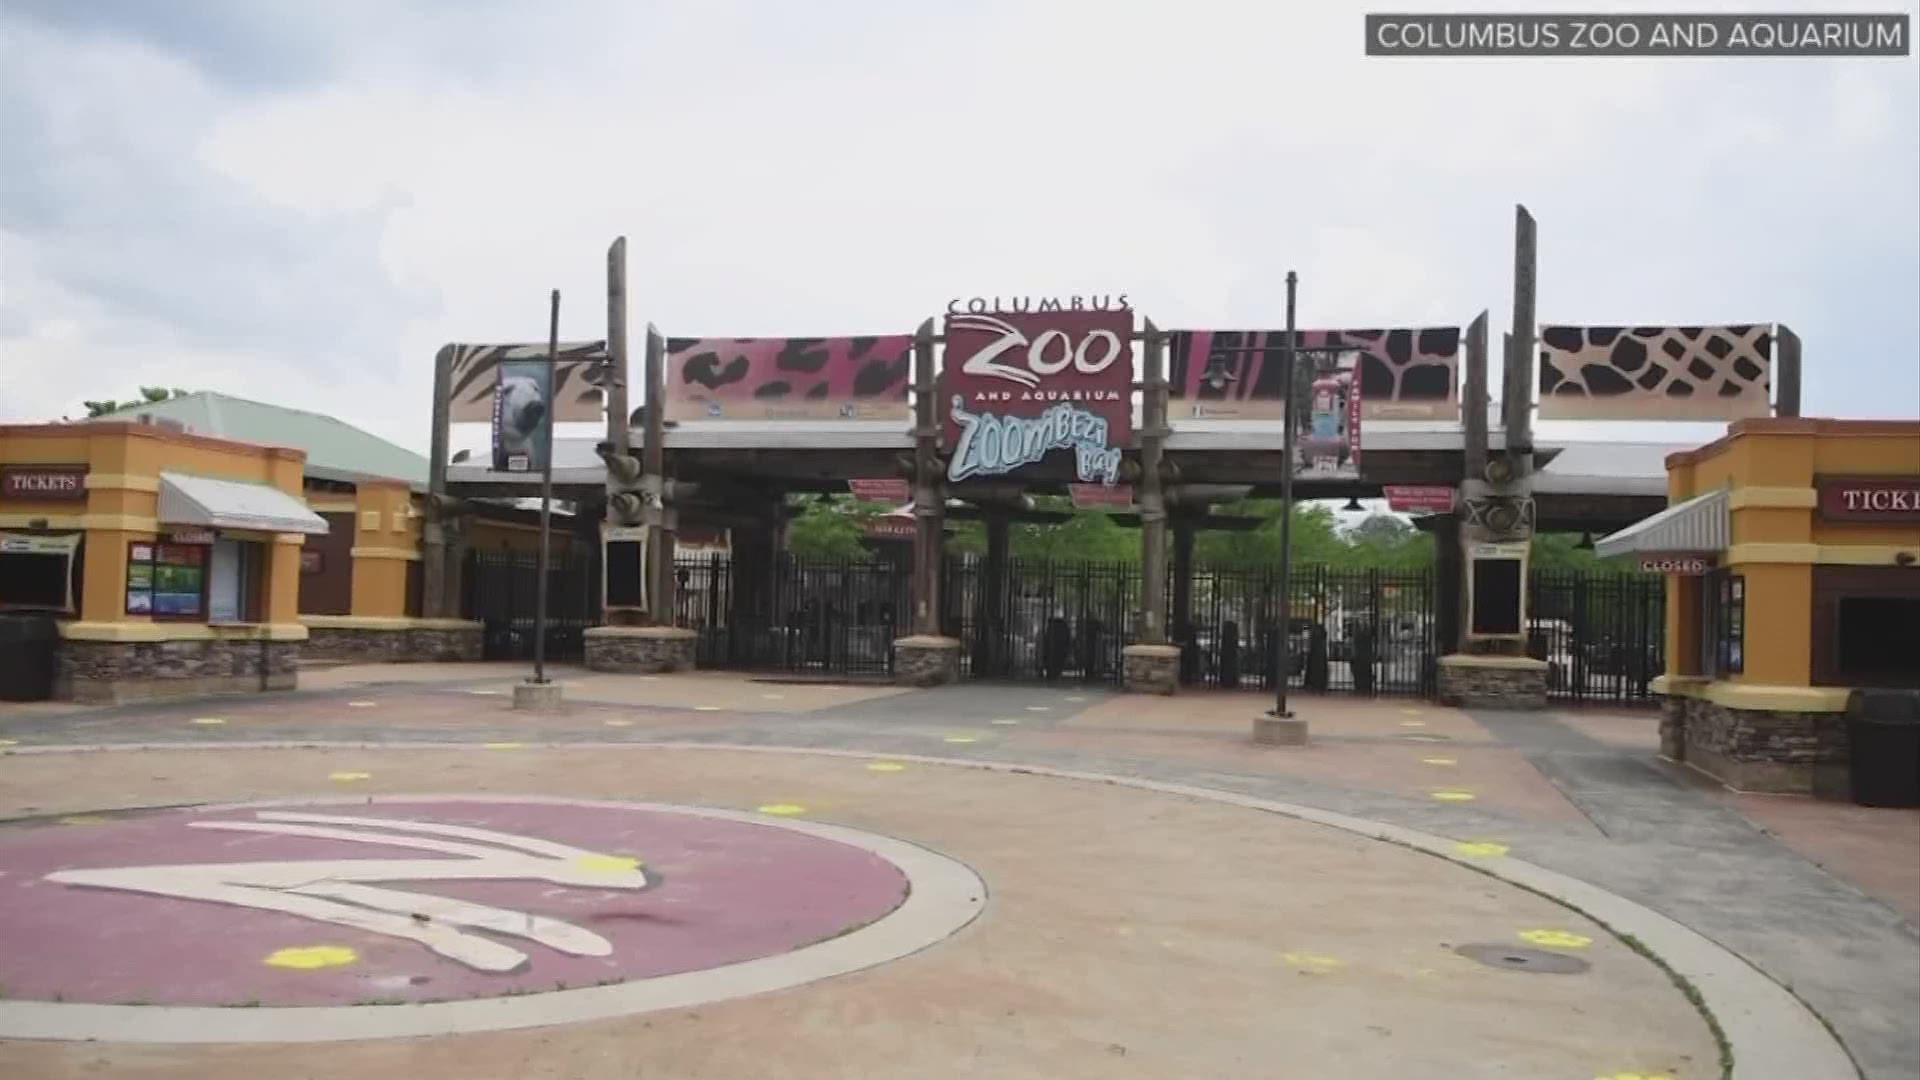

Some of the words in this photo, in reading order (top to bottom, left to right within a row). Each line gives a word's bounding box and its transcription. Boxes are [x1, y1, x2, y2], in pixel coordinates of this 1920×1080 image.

[947, 294, 1129, 314] COLUMBUS
[949, 314, 1122, 388] ZOO
[975, 390, 1012, 401] AND
[1021, 390, 1120, 401] AQUARIUM
[12, 474, 76, 490] TICKETS
[1642, 560, 1703, 572] CLOSED
